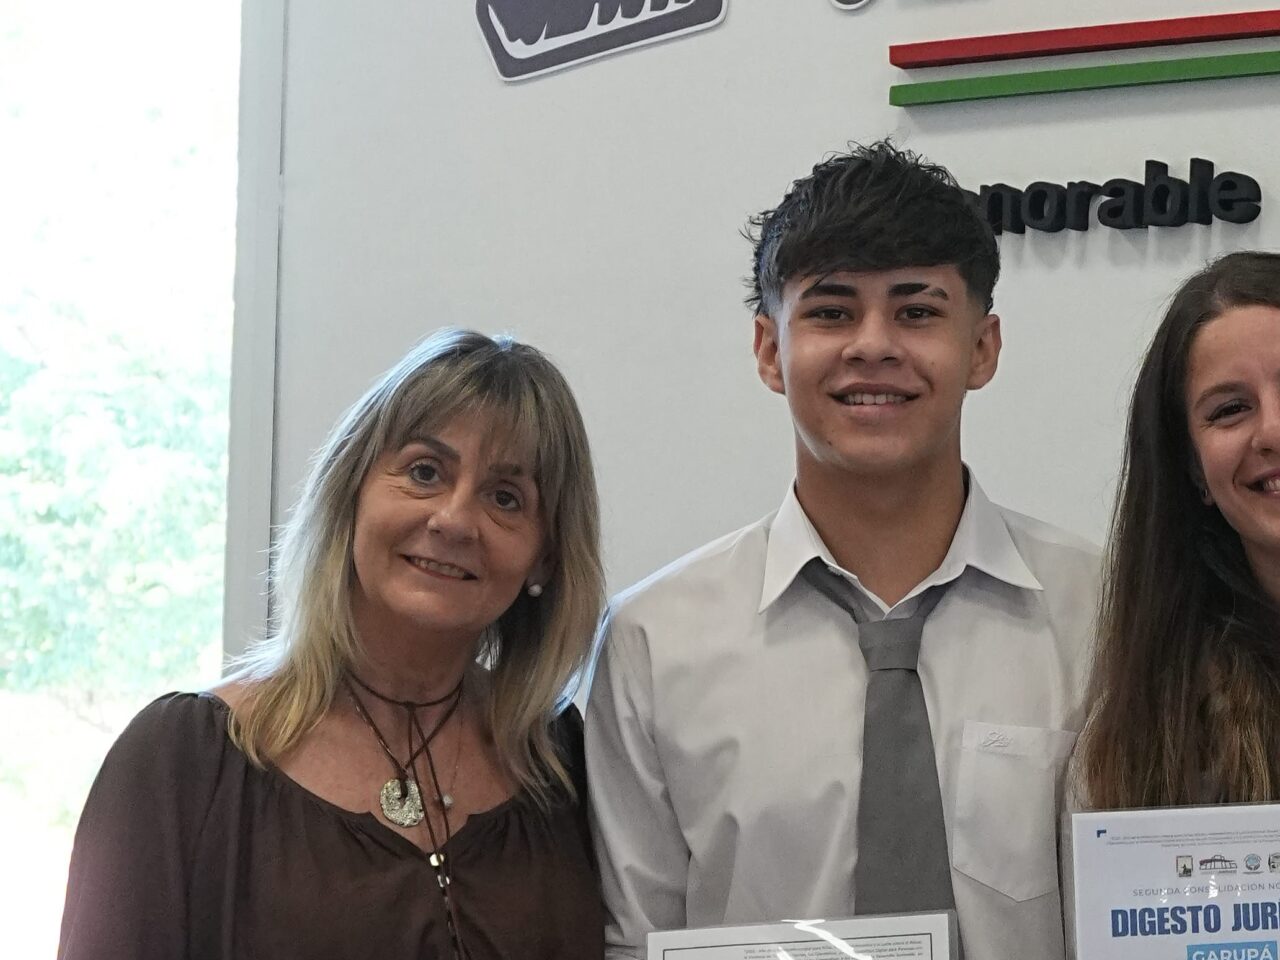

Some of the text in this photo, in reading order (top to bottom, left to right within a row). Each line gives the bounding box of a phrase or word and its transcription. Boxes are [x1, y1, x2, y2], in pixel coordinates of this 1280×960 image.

[963, 158, 1261, 235] norable
[1133, 888, 1180, 897] SEGUNDA
[1111, 904, 1221, 937] DIGESTO
